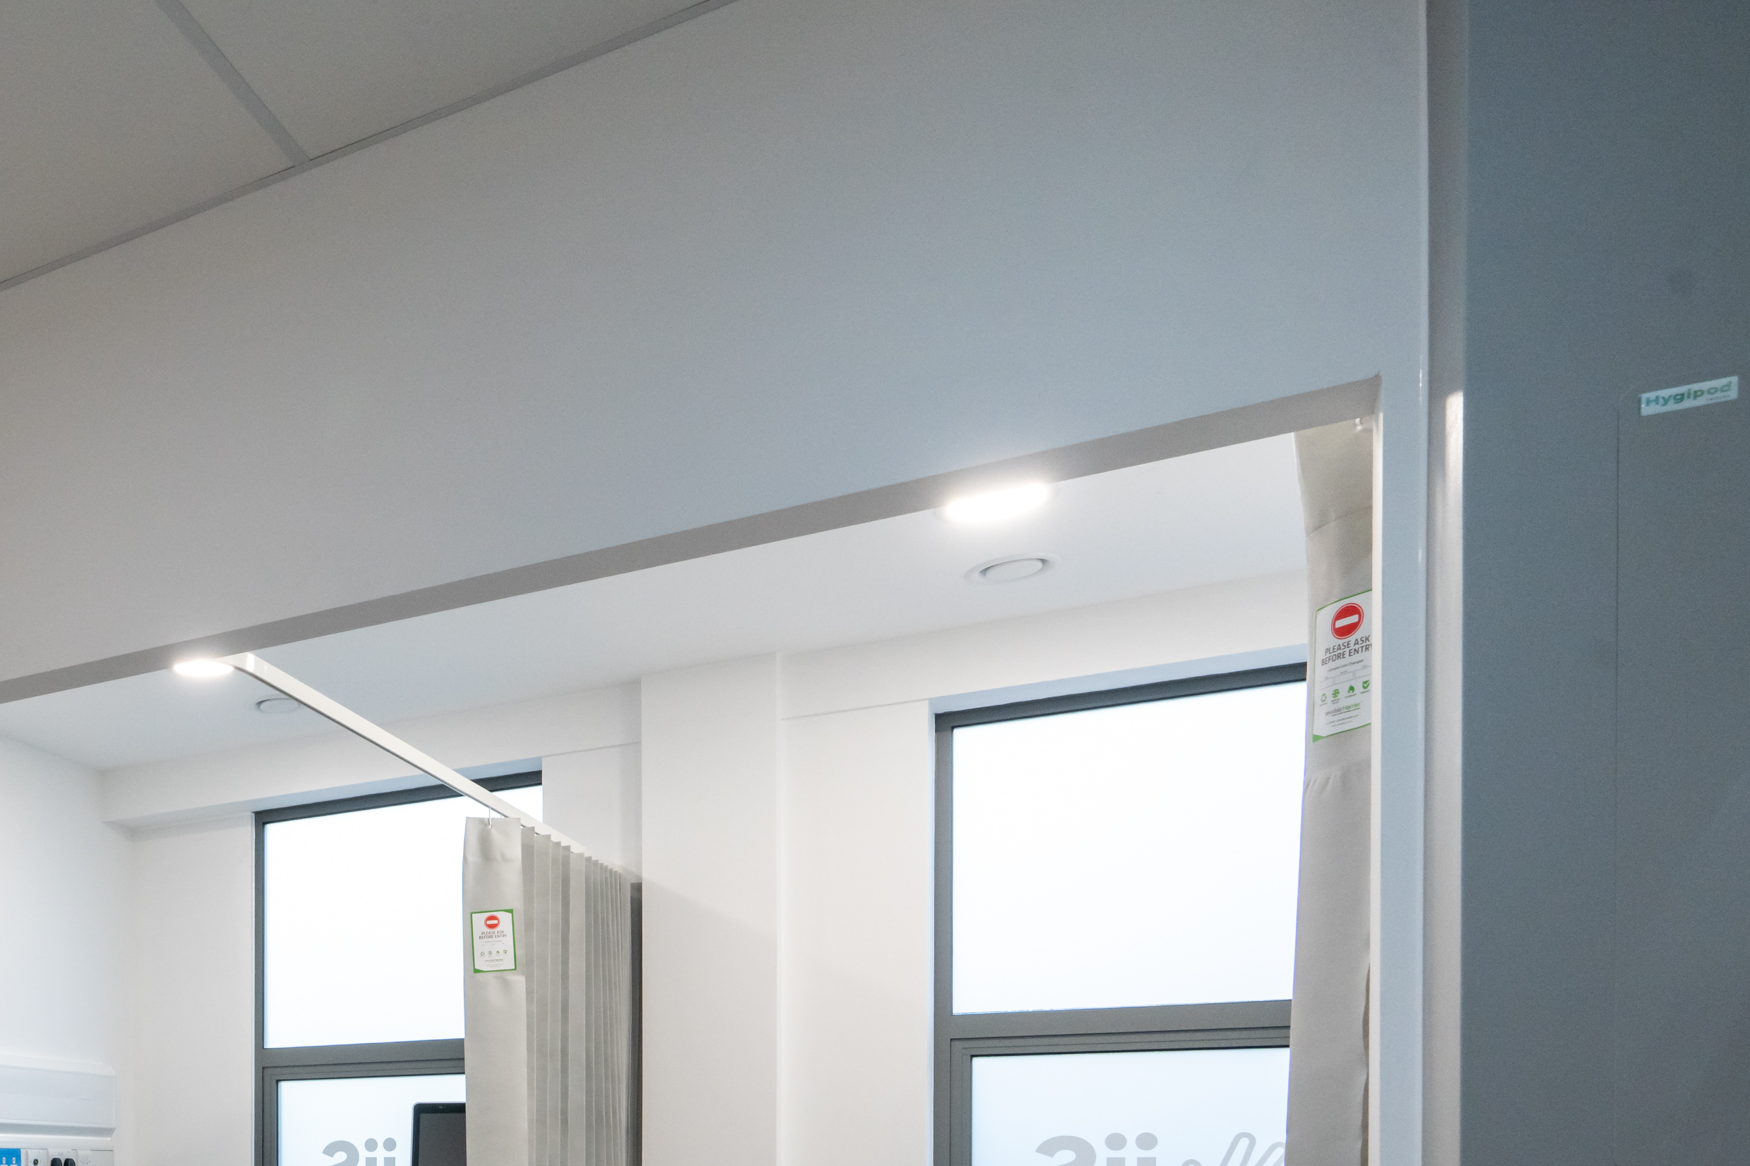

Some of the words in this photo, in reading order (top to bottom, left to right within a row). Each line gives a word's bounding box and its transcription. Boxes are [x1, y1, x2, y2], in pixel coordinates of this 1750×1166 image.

[1645, 380, 1733, 407] Hygipod
[1324, 640, 1352, 656] PLEASE
[1353, 635, 1371, 647] ASK
[1321, 651, 1347, 667] BEFORE
